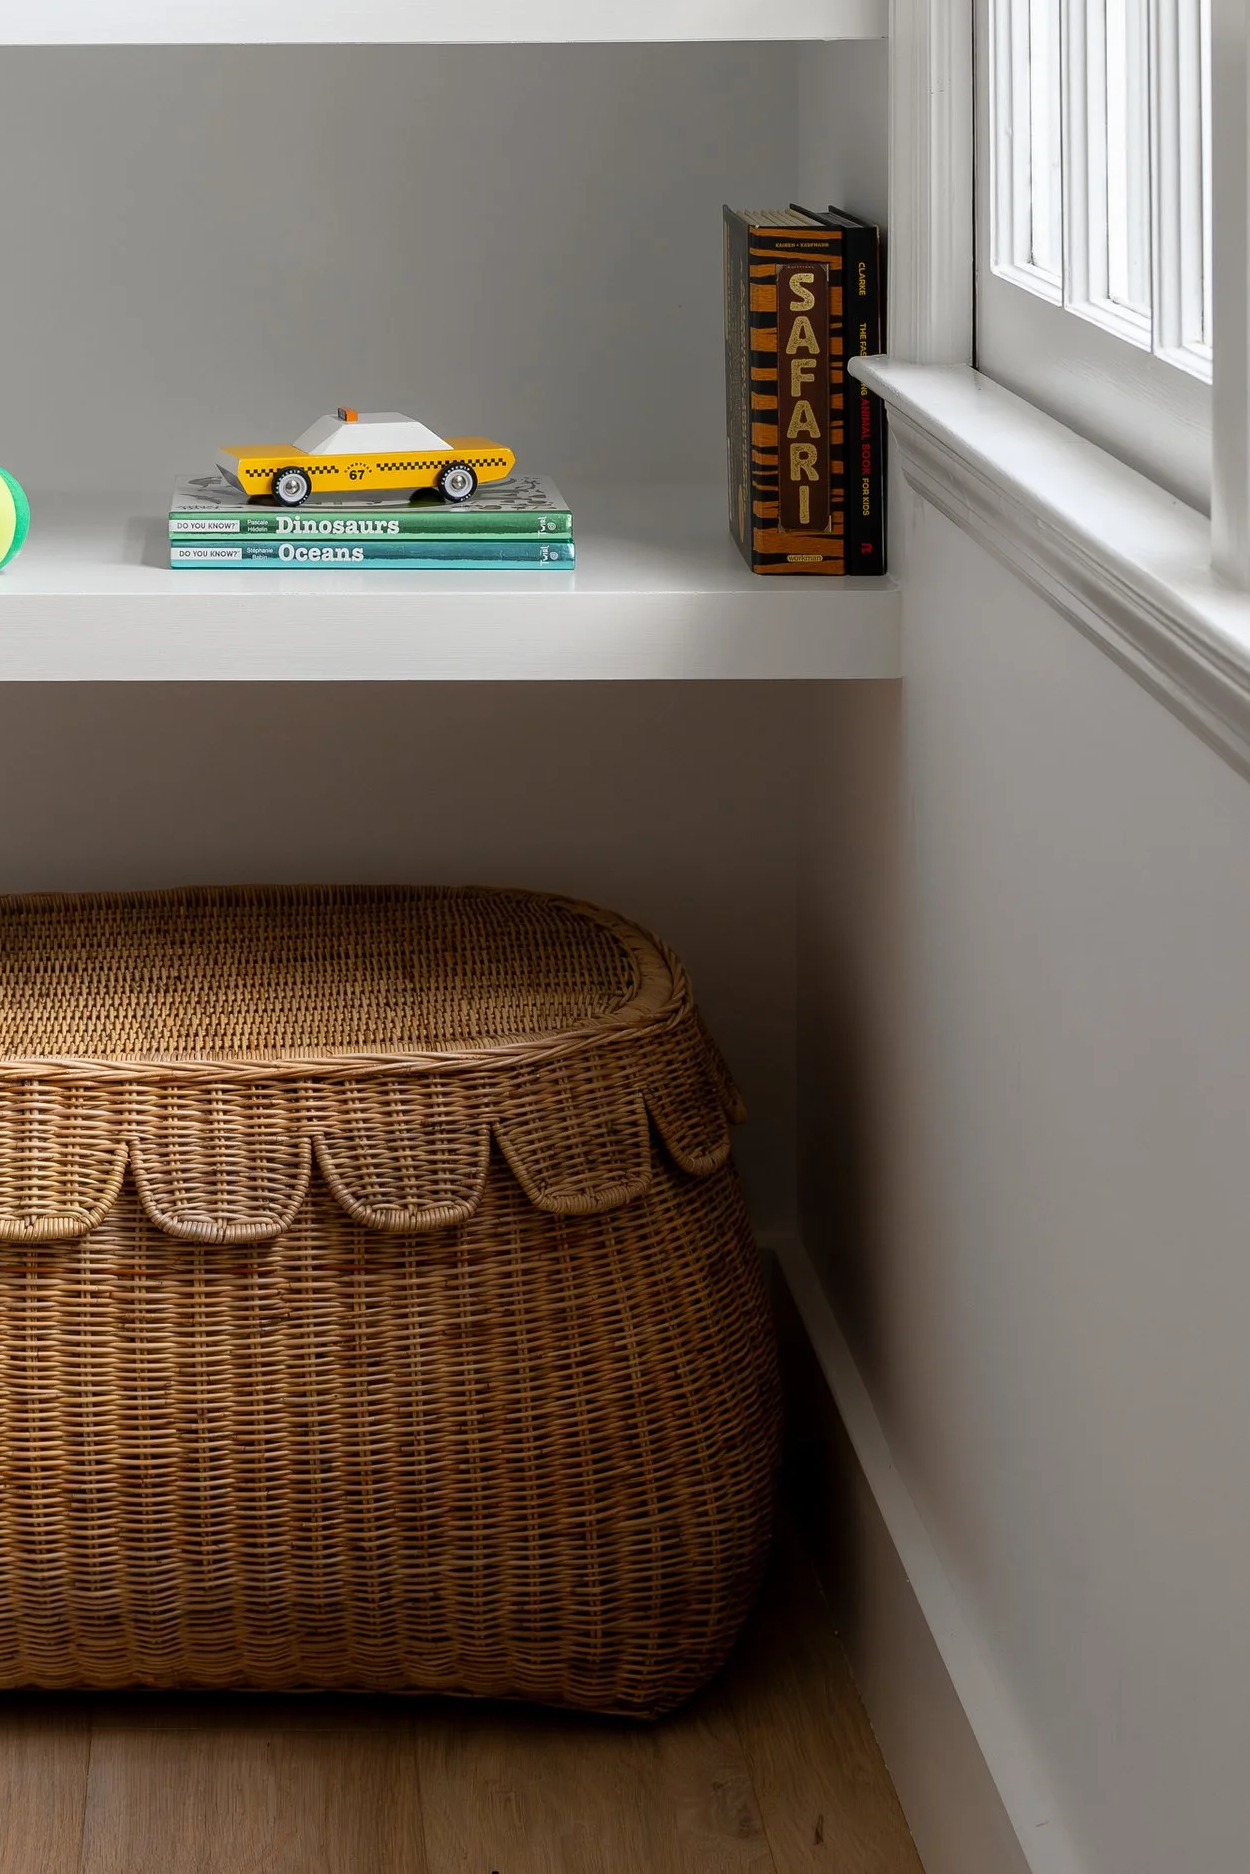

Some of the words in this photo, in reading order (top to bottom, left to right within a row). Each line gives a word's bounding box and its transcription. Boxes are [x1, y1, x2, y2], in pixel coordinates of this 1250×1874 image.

[858, 262, 866, 296] CLARKE
[859, 323, 867, 340] THE
[786, 272, 821, 524] SAFARI
[860, 398, 871, 440] ANIMAL
[349, 469, 365, 480] 67
[861, 478, 870, 496] FOR
[862, 496, 870, 516] KIDS
[275, 515, 400, 534] Dinosaurs
[278, 543, 364, 562] Oceans
